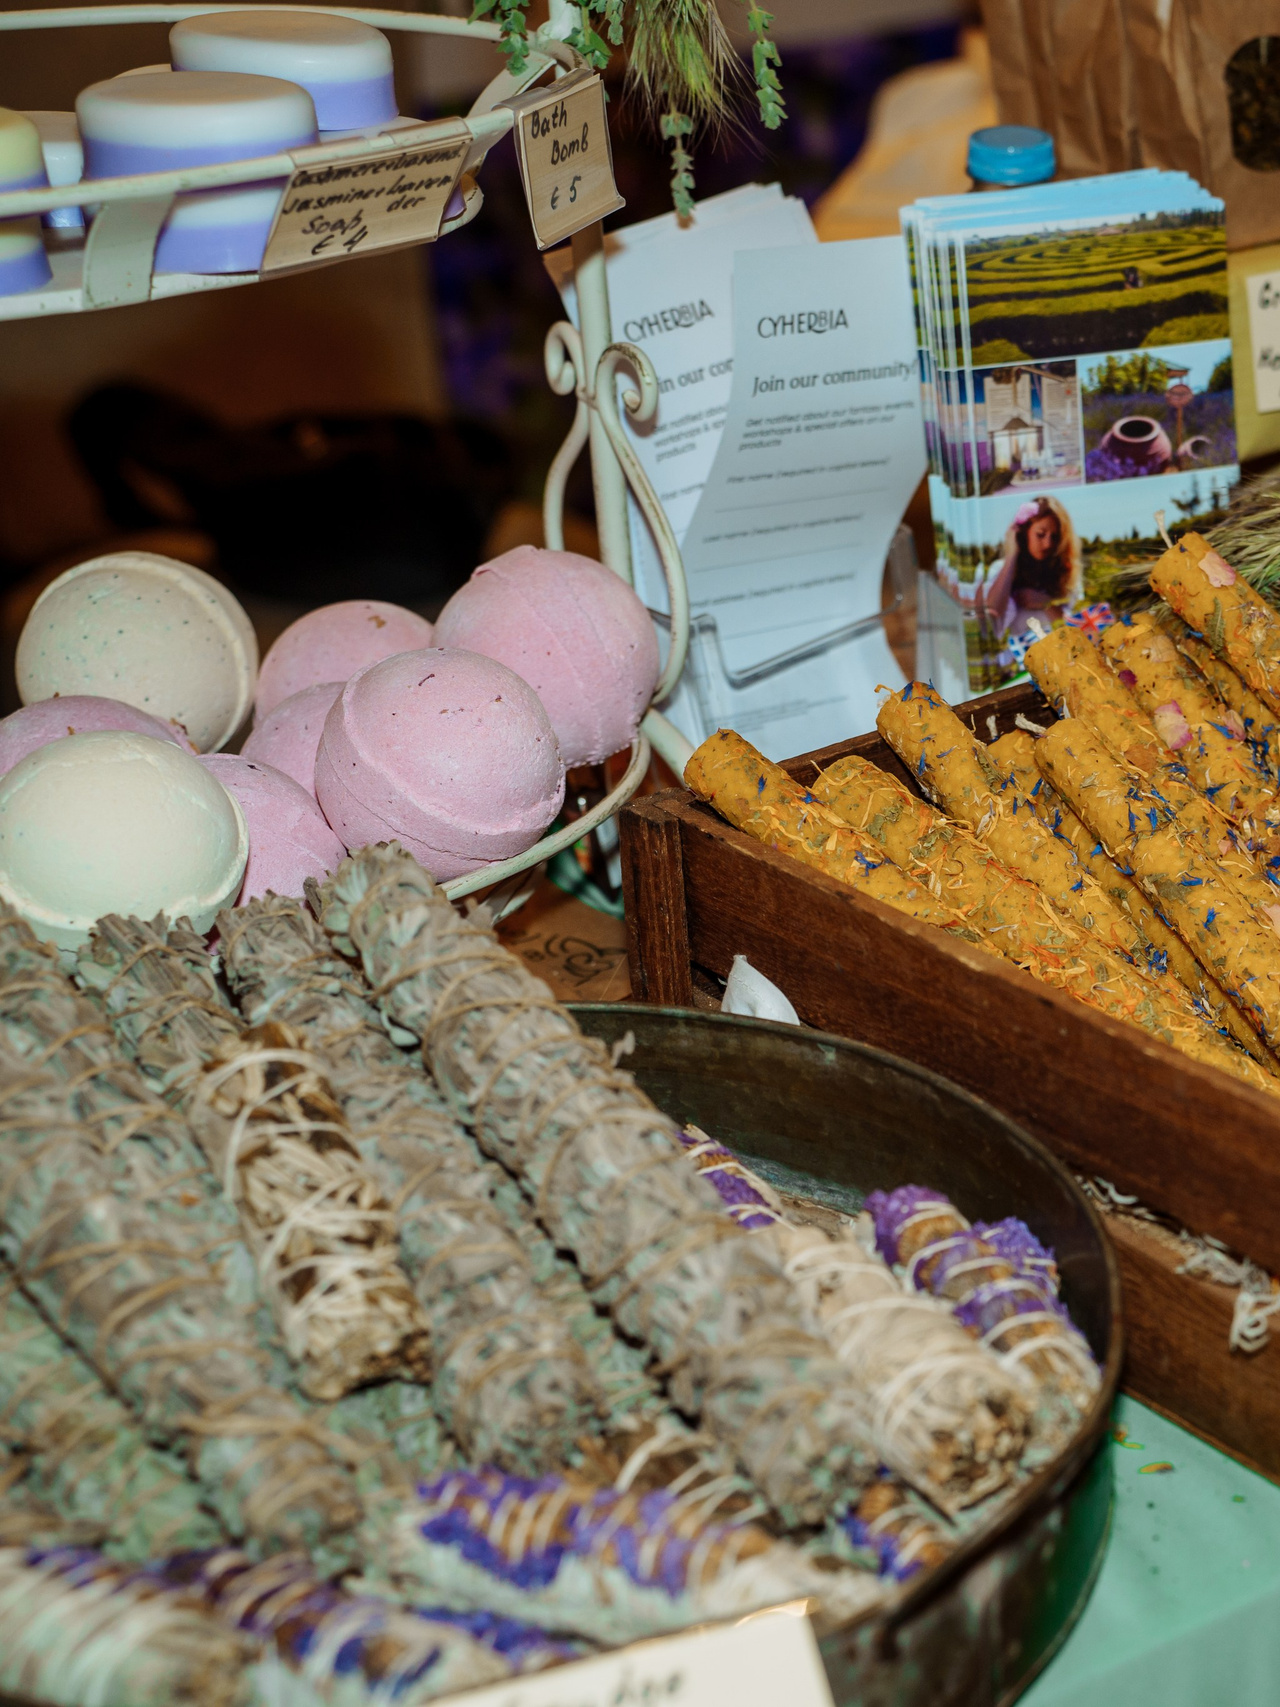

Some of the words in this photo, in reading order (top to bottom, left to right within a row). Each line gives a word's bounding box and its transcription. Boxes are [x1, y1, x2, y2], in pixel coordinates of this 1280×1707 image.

[532, 101, 567, 139] Bath
[551, 122, 588, 165] Bomb
[386, 197, 425, 213] der
[551, 187, 560, 210] €
[570, 175, 581, 203] 5
[302, 210, 362, 235] Soap
[343, 226, 368, 253] 4
[624, 299, 714, 342] CYHERBIA
[757, 309, 849, 338] CYHERBIA
[678, 368, 705, 388] our
[752, 375, 785, 397] Join
[789, 373, 819, 390] our
